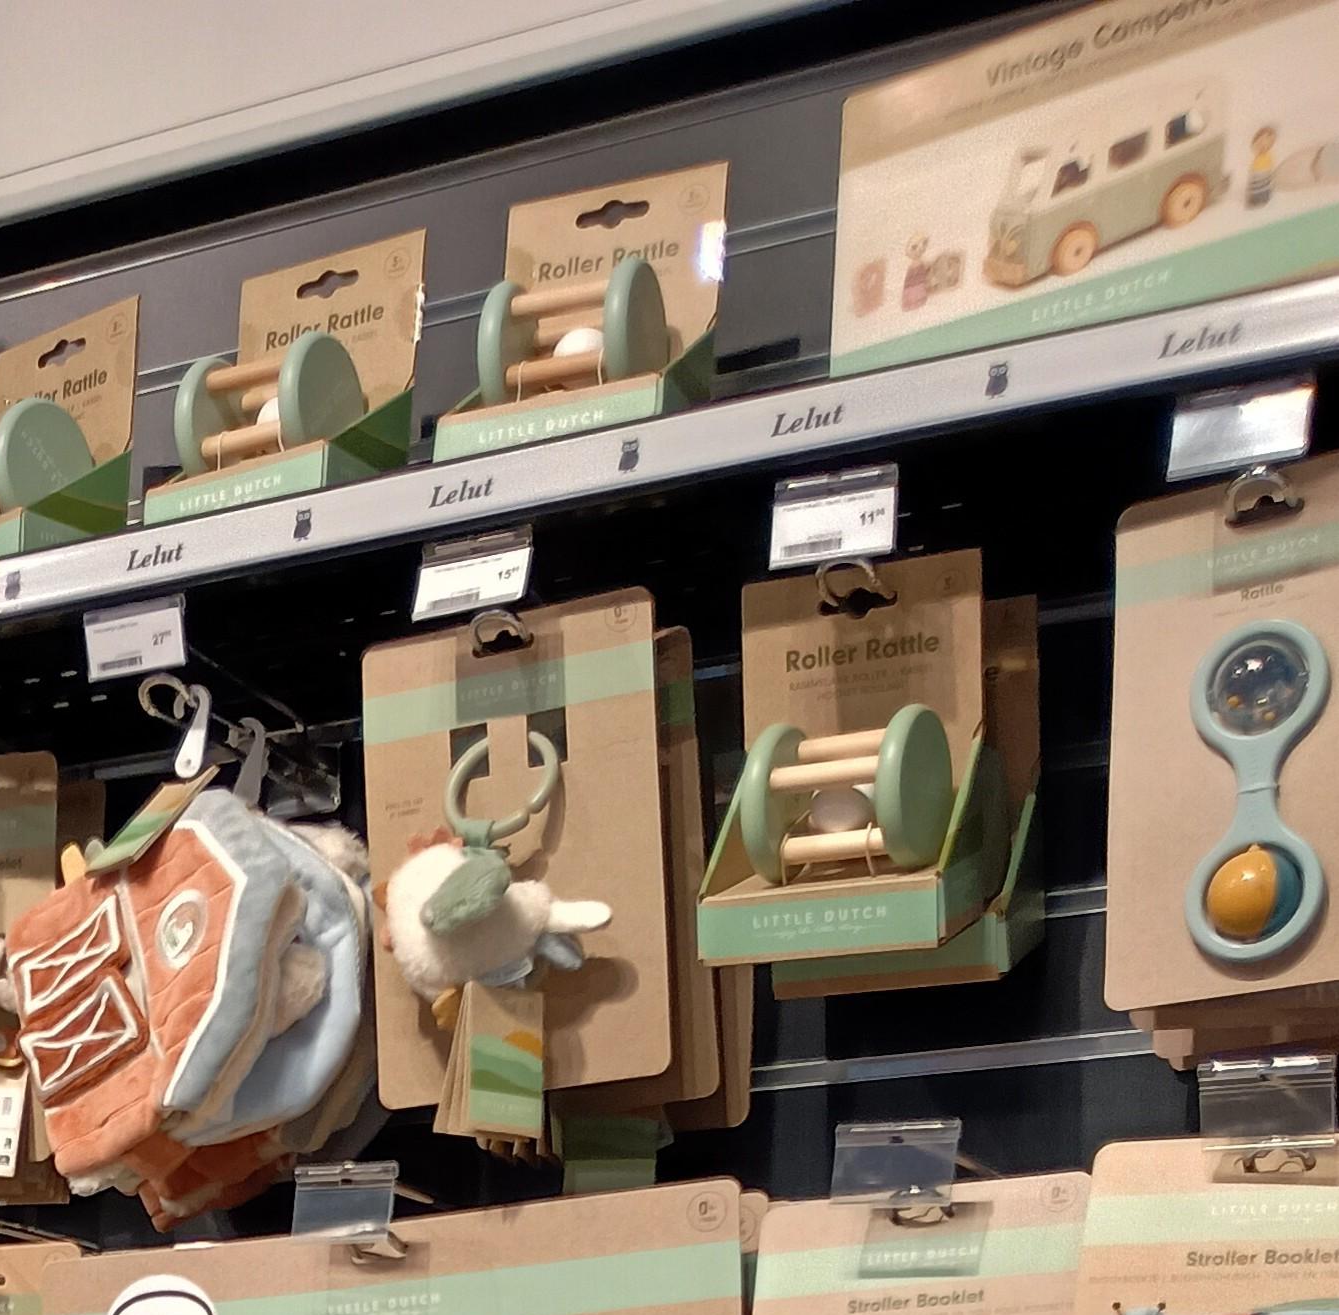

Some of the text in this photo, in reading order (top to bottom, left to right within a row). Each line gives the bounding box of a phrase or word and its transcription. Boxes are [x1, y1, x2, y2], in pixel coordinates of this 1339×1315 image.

[986, 35, 1082, 89] Vintage
[538, 257, 603, 283] Roller
[1032, 269, 1171, 323] LITTLE DUTCH
[265, 303, 384, 352] Roller Rattle
[1156, 321, 1244, 361] Lelut
[61, 369, 108, 402] Rattle
[478, 409, 605, 446] LITTLE DUTCH
[771, 403, 844, 438] Lelut
[179, 474, 283, 512] LITTLE DUTCH
[429, 478, 493, 509] Lelut
[127, 542, 184, 572] Lelut
[1240, 580, 1284, 602] Rattle
[785, 629, 941, 674] Roller Rattle
[753, 904, 888, 929] LITTLE DUTCH
[1185, 1247, 1260, 1270] Stroller
[846, 1287, 987, 1315] Stroller Booklet
